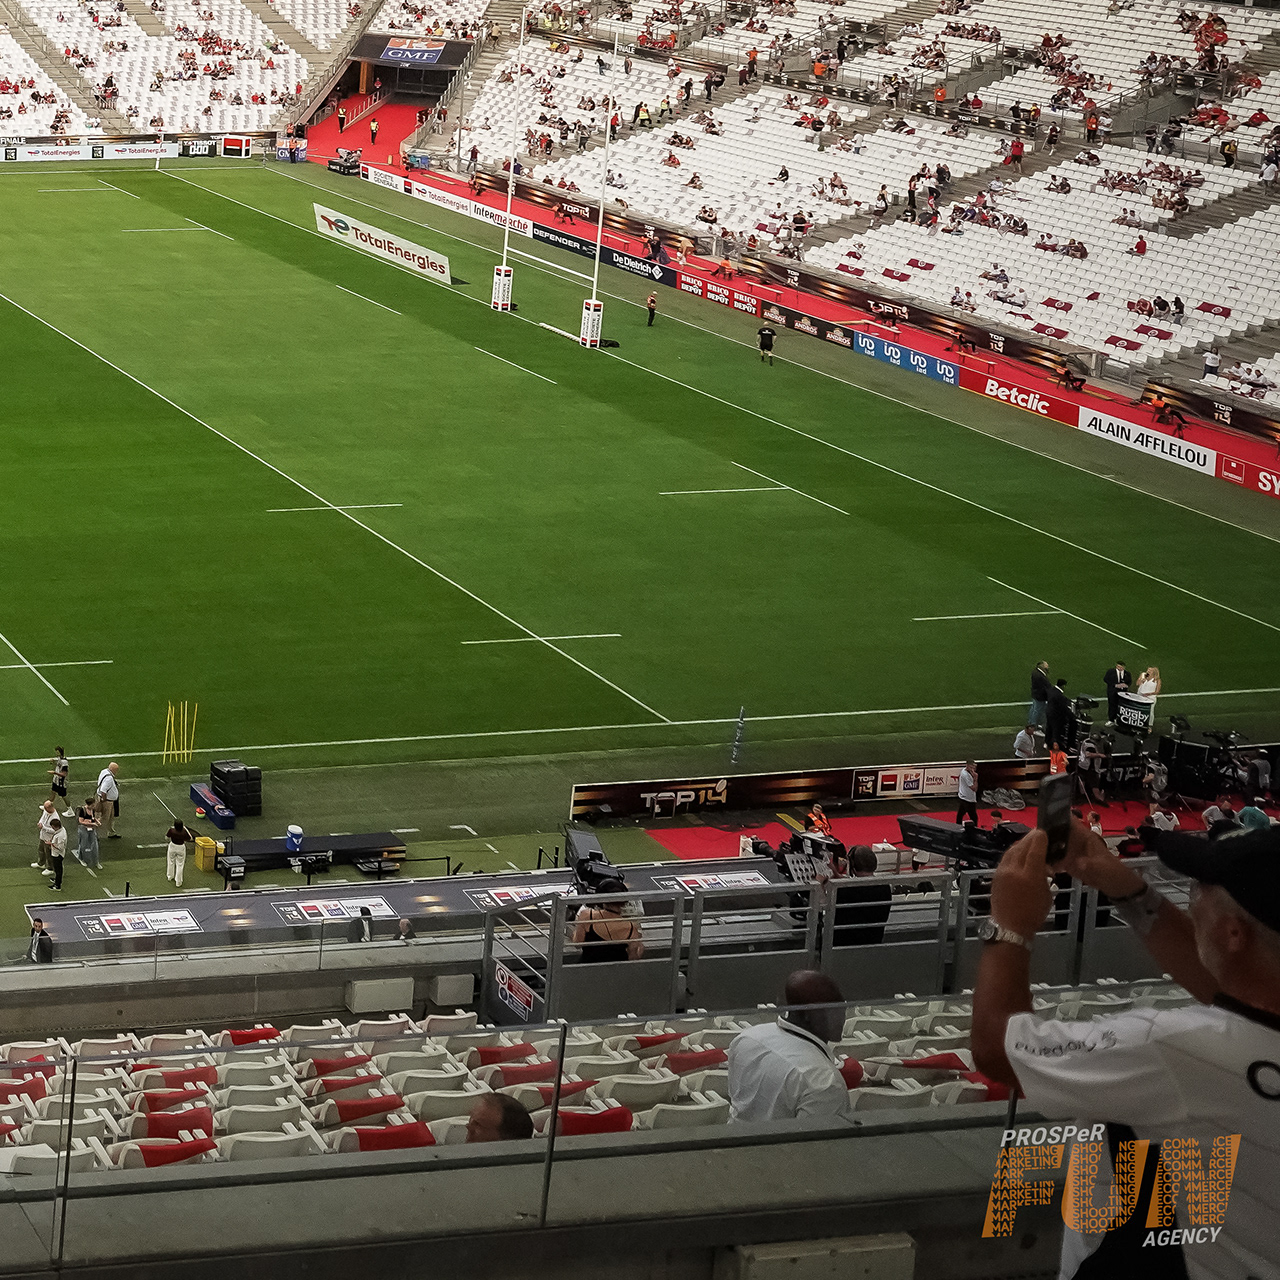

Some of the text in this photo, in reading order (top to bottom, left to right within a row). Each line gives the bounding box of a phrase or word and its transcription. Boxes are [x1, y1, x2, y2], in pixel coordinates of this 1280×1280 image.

[389, 50, 437, 61] GMF
[428, 190, 468, 211] TotalEnergies
[561, 202, 590, 218] TOP14
[474, 205, 529, 232] Intermarché
[533, 229, 580, 249] DEFENDER
[351, 227, 446, 275] TotalEnergies
[613, 252, 623, 262] De
[624, 256, 651, 273] Dietrich
[681, 274, 702, 287] BRICO
[707, 282, 729, 296] BRICO
[734, 292, 756, 305] BRICO
[763, 311, 786, 324] ANDROS
[795, 321, 818, 335] ANDROS
[826, 332, 852, 347] ANDROS
[989, 333, 1004, 341] TOP
[985, 378, 1050, 414] Betclic
[1214, 402, 1232, 411] TOP
[1087, 416, 1207, 467] ALAIN AFFLELOU
[1120, 706, 1149, 722] Rugby
[1120, 715, 1144, 727] Club
[857, 775, 875, 783] TOP
[904, 781, 920, 790] GMF
